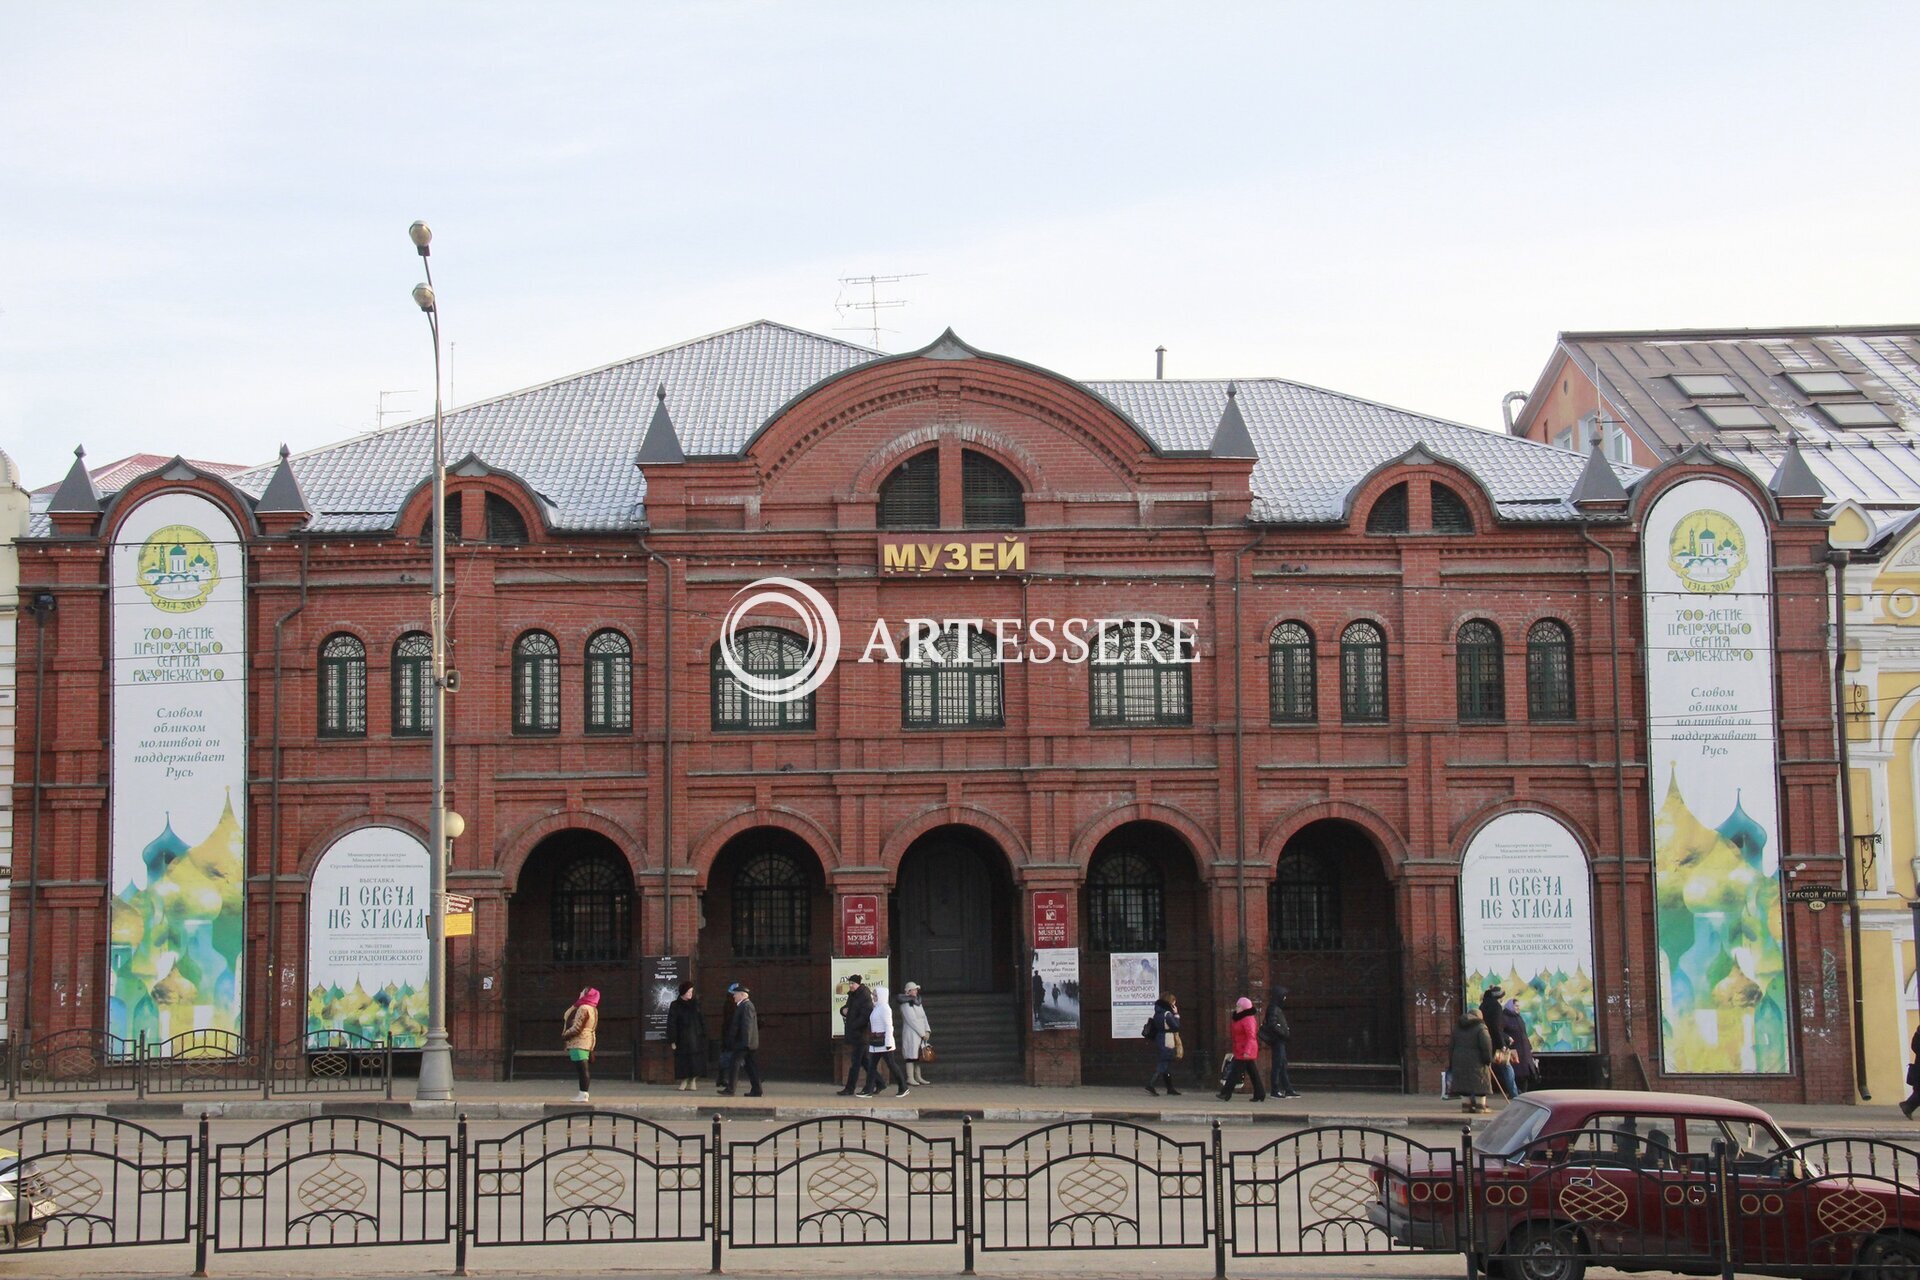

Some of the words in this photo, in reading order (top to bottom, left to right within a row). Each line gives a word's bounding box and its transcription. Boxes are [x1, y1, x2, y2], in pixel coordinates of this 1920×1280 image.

[884, 536, 1025, 572] МУЗЕЙ
[1687, 581, 1730, 592] 1314-2014
[156, 598, 202, 610] 1314-2014
[1676, 609, 1743, 621] 700-ЛЕТИЕ
[144, 627, 214, 640] 700-ЛЕТИЕ
[1667, 623, 1752, 635] ПРЕПОДОБНОГО
[134, 641, 223, 655] ПРЕПОДОБНОГО
[1690, 636, 1730, 648] СЕРГИЯ
[157, 655, 200, 667] СЕРГИЯ
[1667, 649, 1753, 662] РАДОНЕЖСКОГО
[133, 668, 224, 682] РАДОНЕЖСКОГО
[1691, 687, 1734, 698] Словом
[156, 707, 203, 718] Словом
[1688, 702, 1738, 712] обликом
[153, 722, 206, 733] обликом
[1675, 716, 1735, 727] молитвой
[1738, 718, 1752, 726] он
[138, 737, 202, 748] молитвой
[205, 739, 220, 747] он
[1671, 730, 1757, 743] поддерживает
[1702, 745, 1728, 758] Русь
[134, 752, 225, 765] поддерживает
[165, 767, 194, 780] Русь
[1490, 877, 1499, 896] И
[1509, 876, 1562, 896] СВЕЧА
[339, 886, 349, 906] И
[360, 885, 414, 906] СВЕЧА
[1481, 899, 1502, 919] НЕ
[328, 909, 351, 929] НЕ
